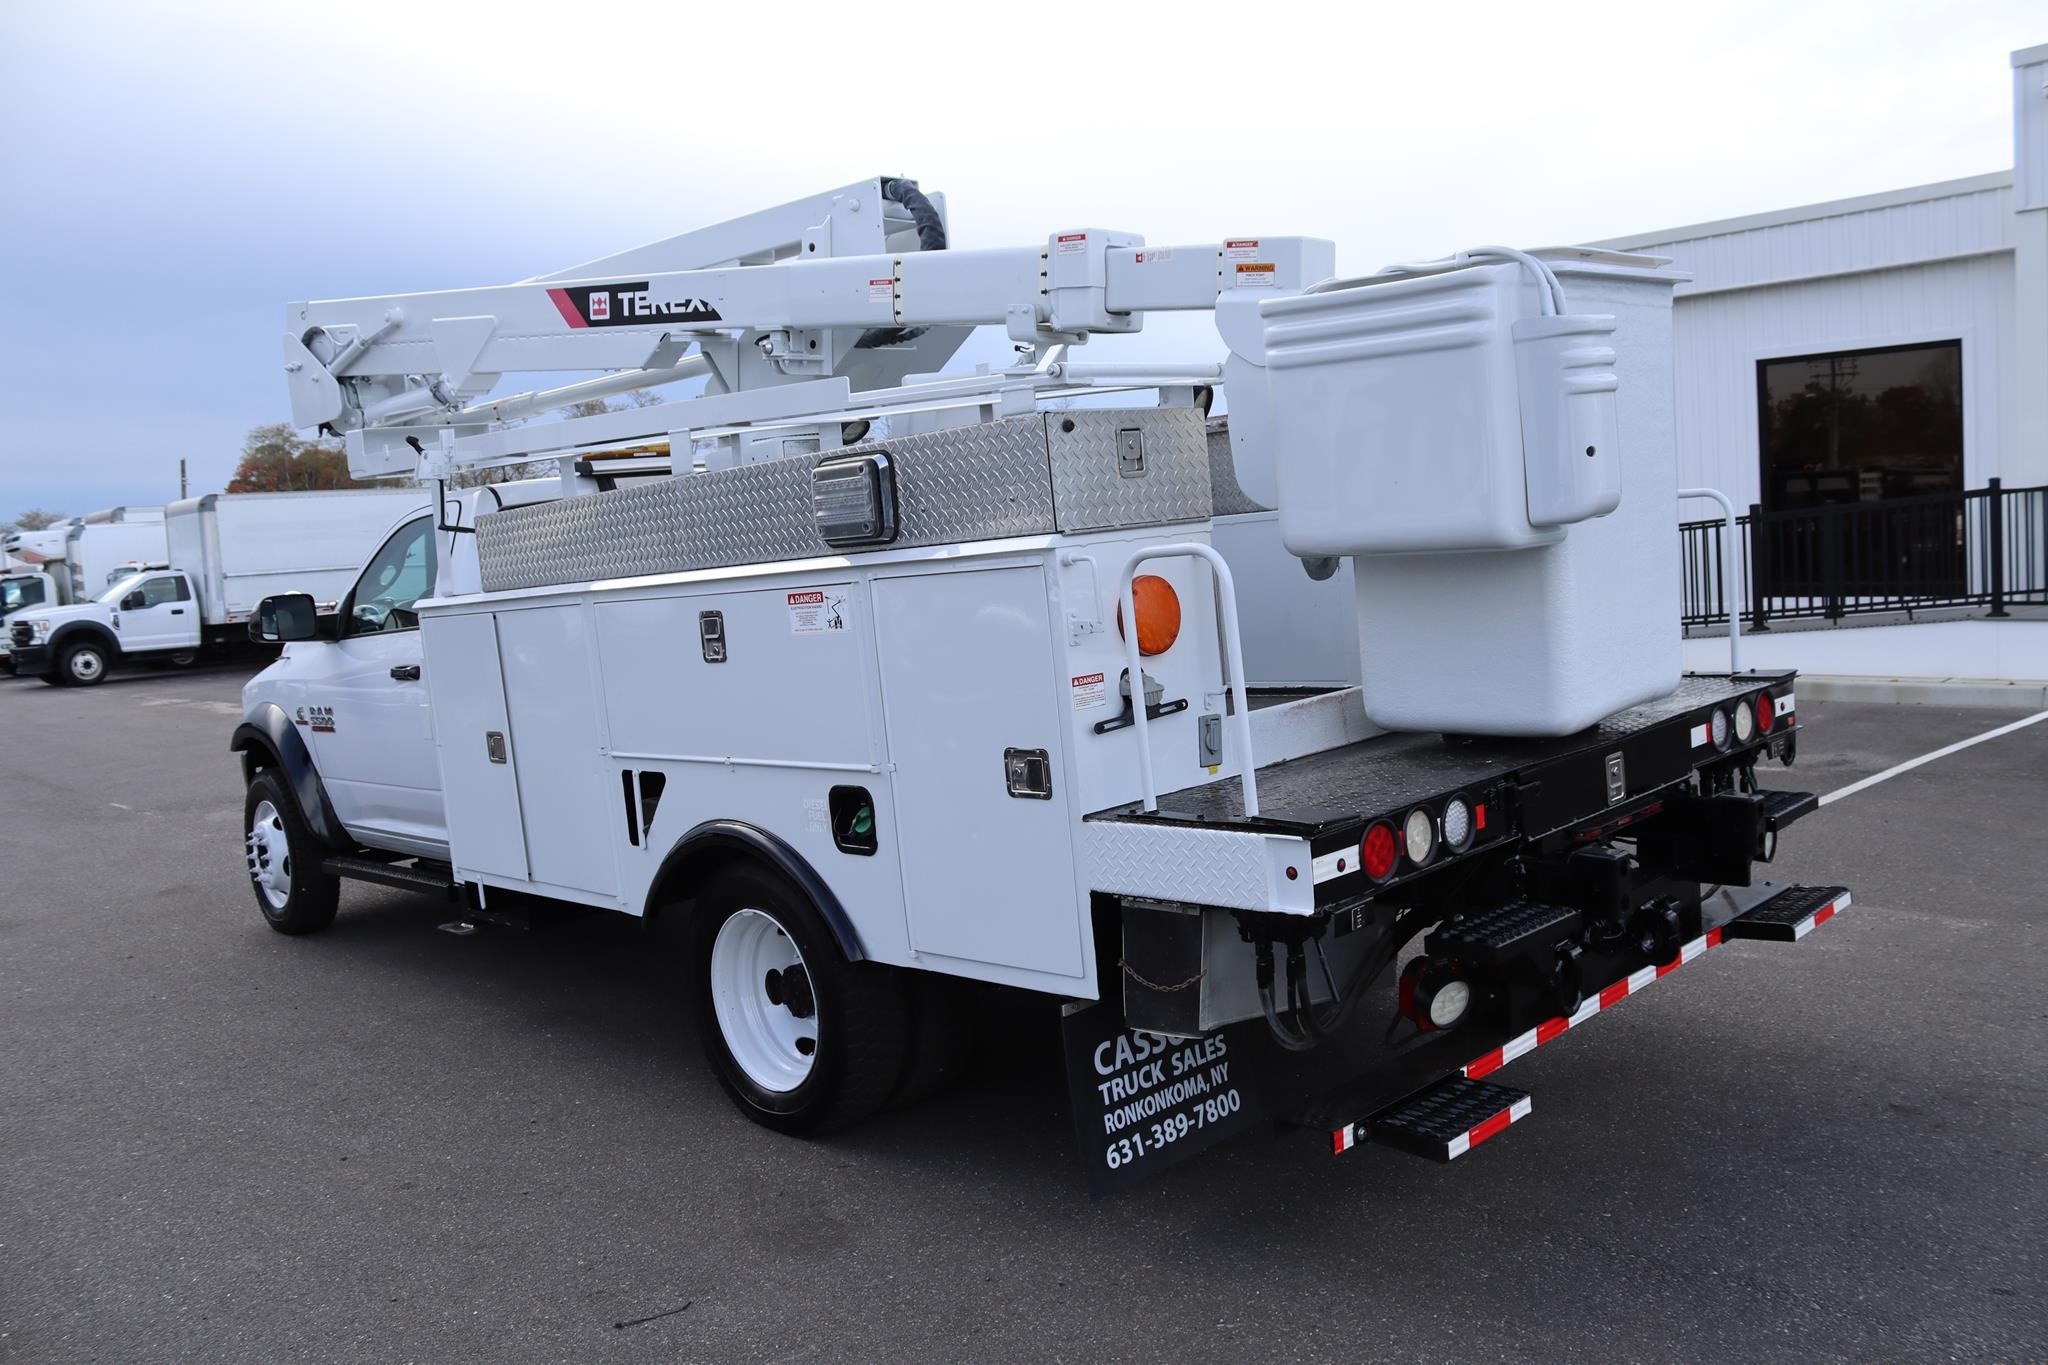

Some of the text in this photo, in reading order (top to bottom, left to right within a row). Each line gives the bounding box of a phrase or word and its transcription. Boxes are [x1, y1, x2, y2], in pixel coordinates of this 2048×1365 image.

[794, 593, 823, 604] DANGER
[1079, 674, 1103, 685] DANGER
[309, 706, 333, 716] RAM
[1098, 1034, 1227, 1106] TRUCK SALES
[1104, 1062, 1230, 1135] RONKONKOMA, NY
[1106, 1088, 1241, 1170] 631-389-7800
